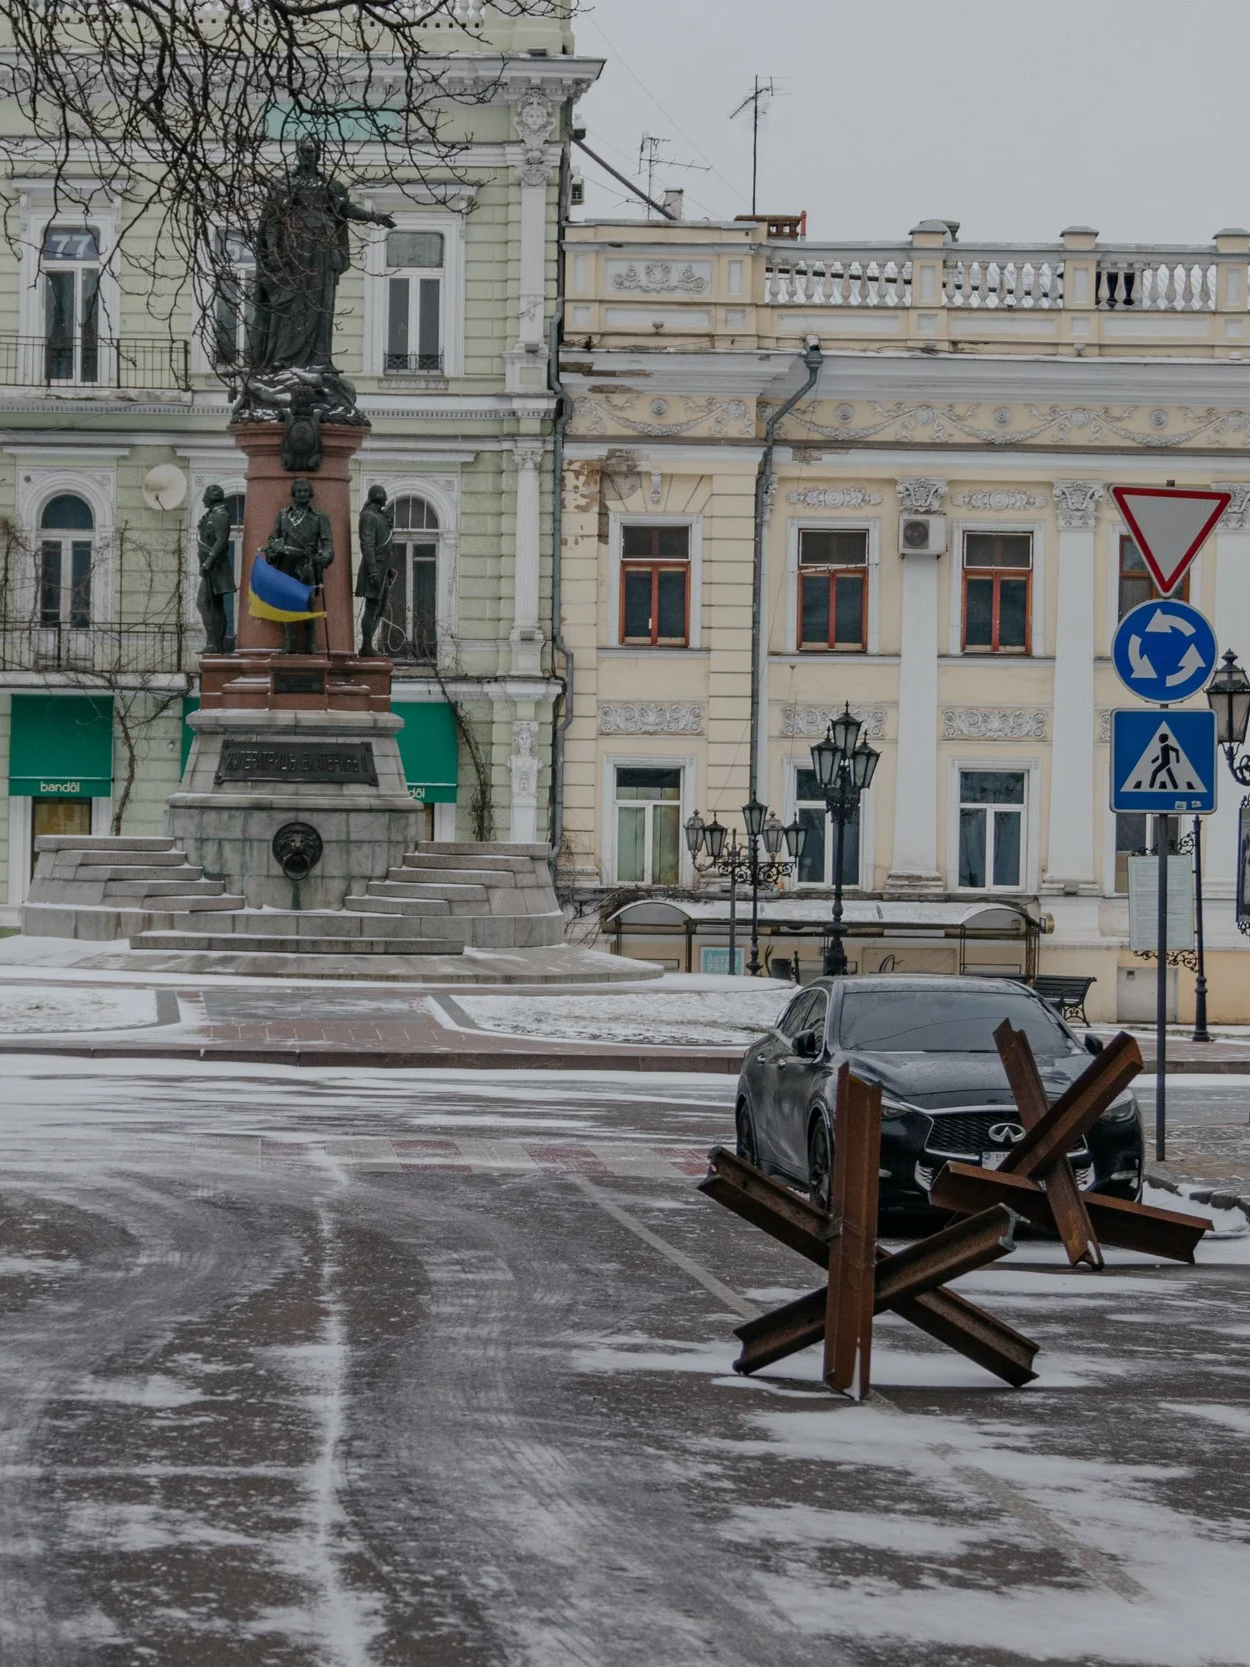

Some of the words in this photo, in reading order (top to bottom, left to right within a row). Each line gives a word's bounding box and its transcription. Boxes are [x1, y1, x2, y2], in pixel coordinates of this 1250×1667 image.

[51, 234, 92, 258] 77
[40, 781, 80, 793] bandôl
[407, 787, 426, 799] dôl
